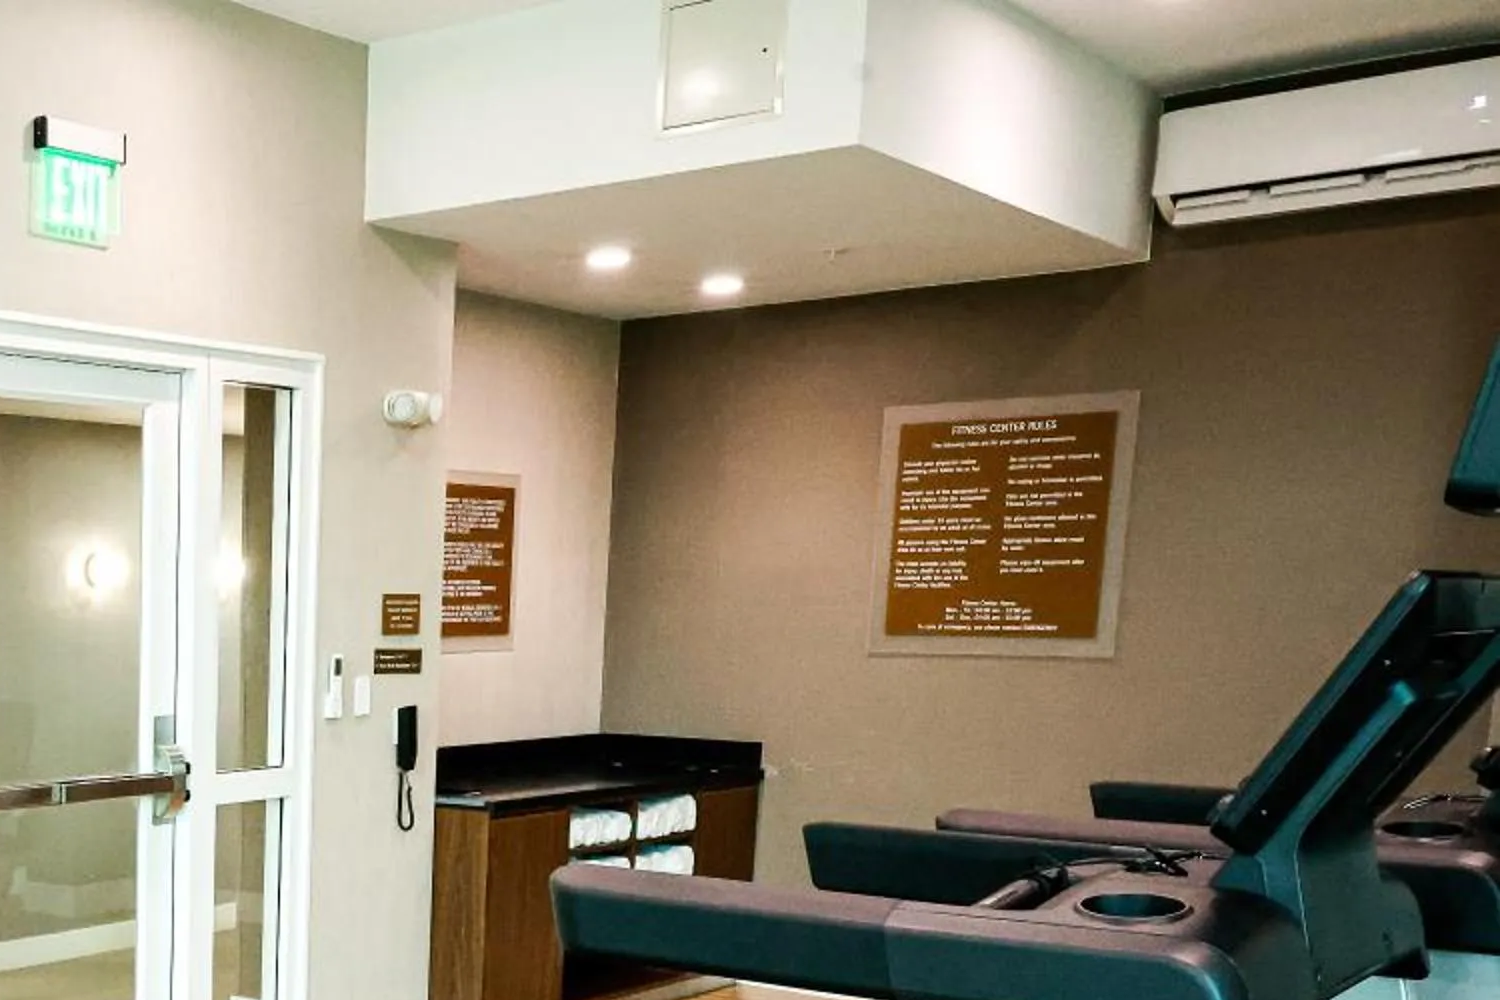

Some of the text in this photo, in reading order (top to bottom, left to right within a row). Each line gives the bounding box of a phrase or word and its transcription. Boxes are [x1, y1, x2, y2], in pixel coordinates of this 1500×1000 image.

[49, 157, 106, 225] EXIT
[951, 419, 1058, 436] FITNESS CENTER RULES
